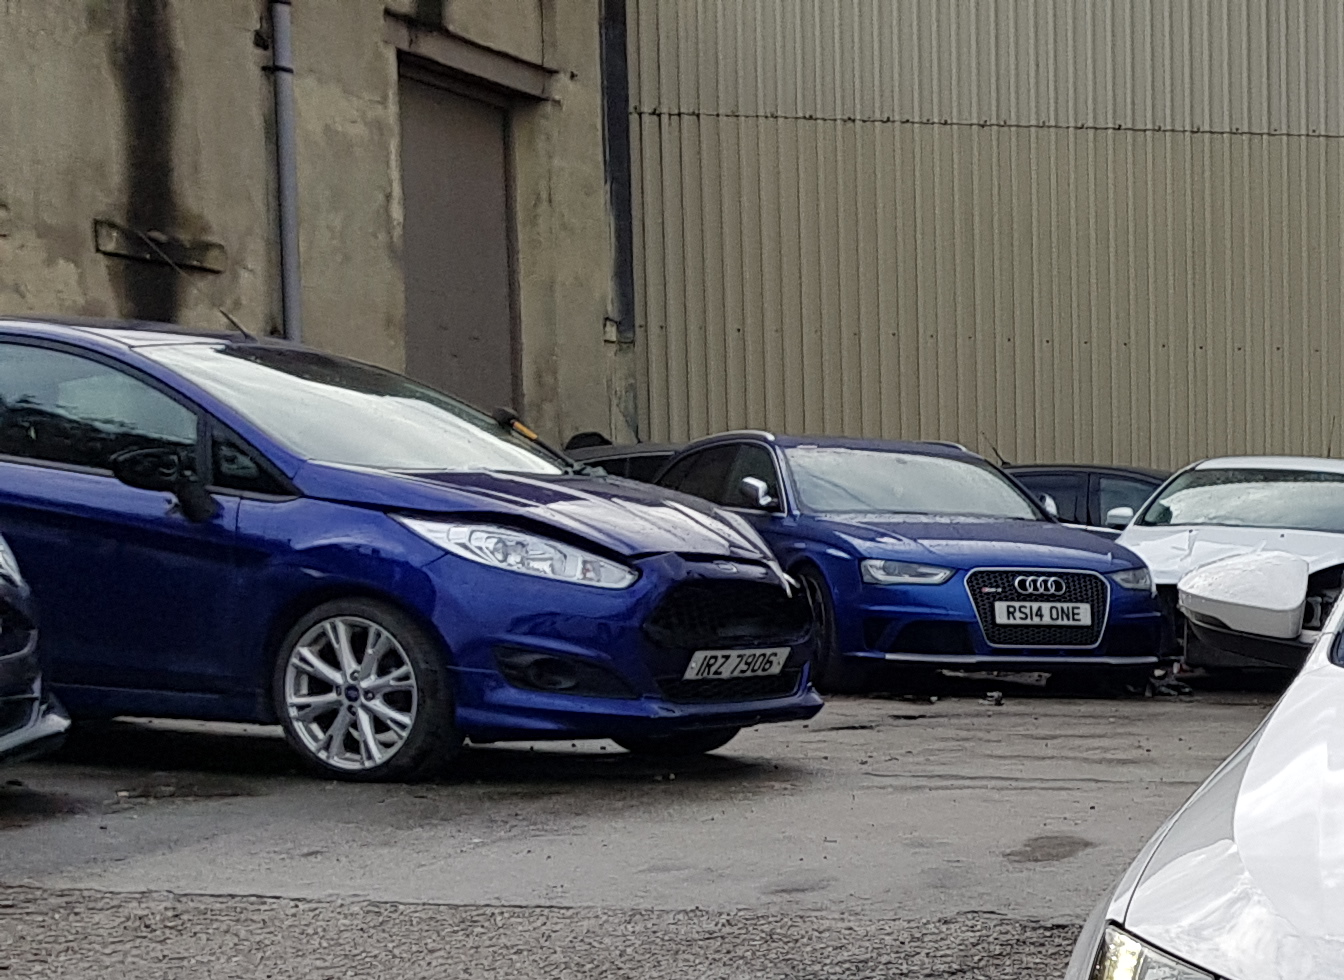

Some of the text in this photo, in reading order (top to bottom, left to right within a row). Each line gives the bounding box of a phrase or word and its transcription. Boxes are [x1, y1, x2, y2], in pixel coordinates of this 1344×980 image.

[1006, 604, 1082, 622] RS14 ONE
[695, 651, 778, 677] IRZ 7906
